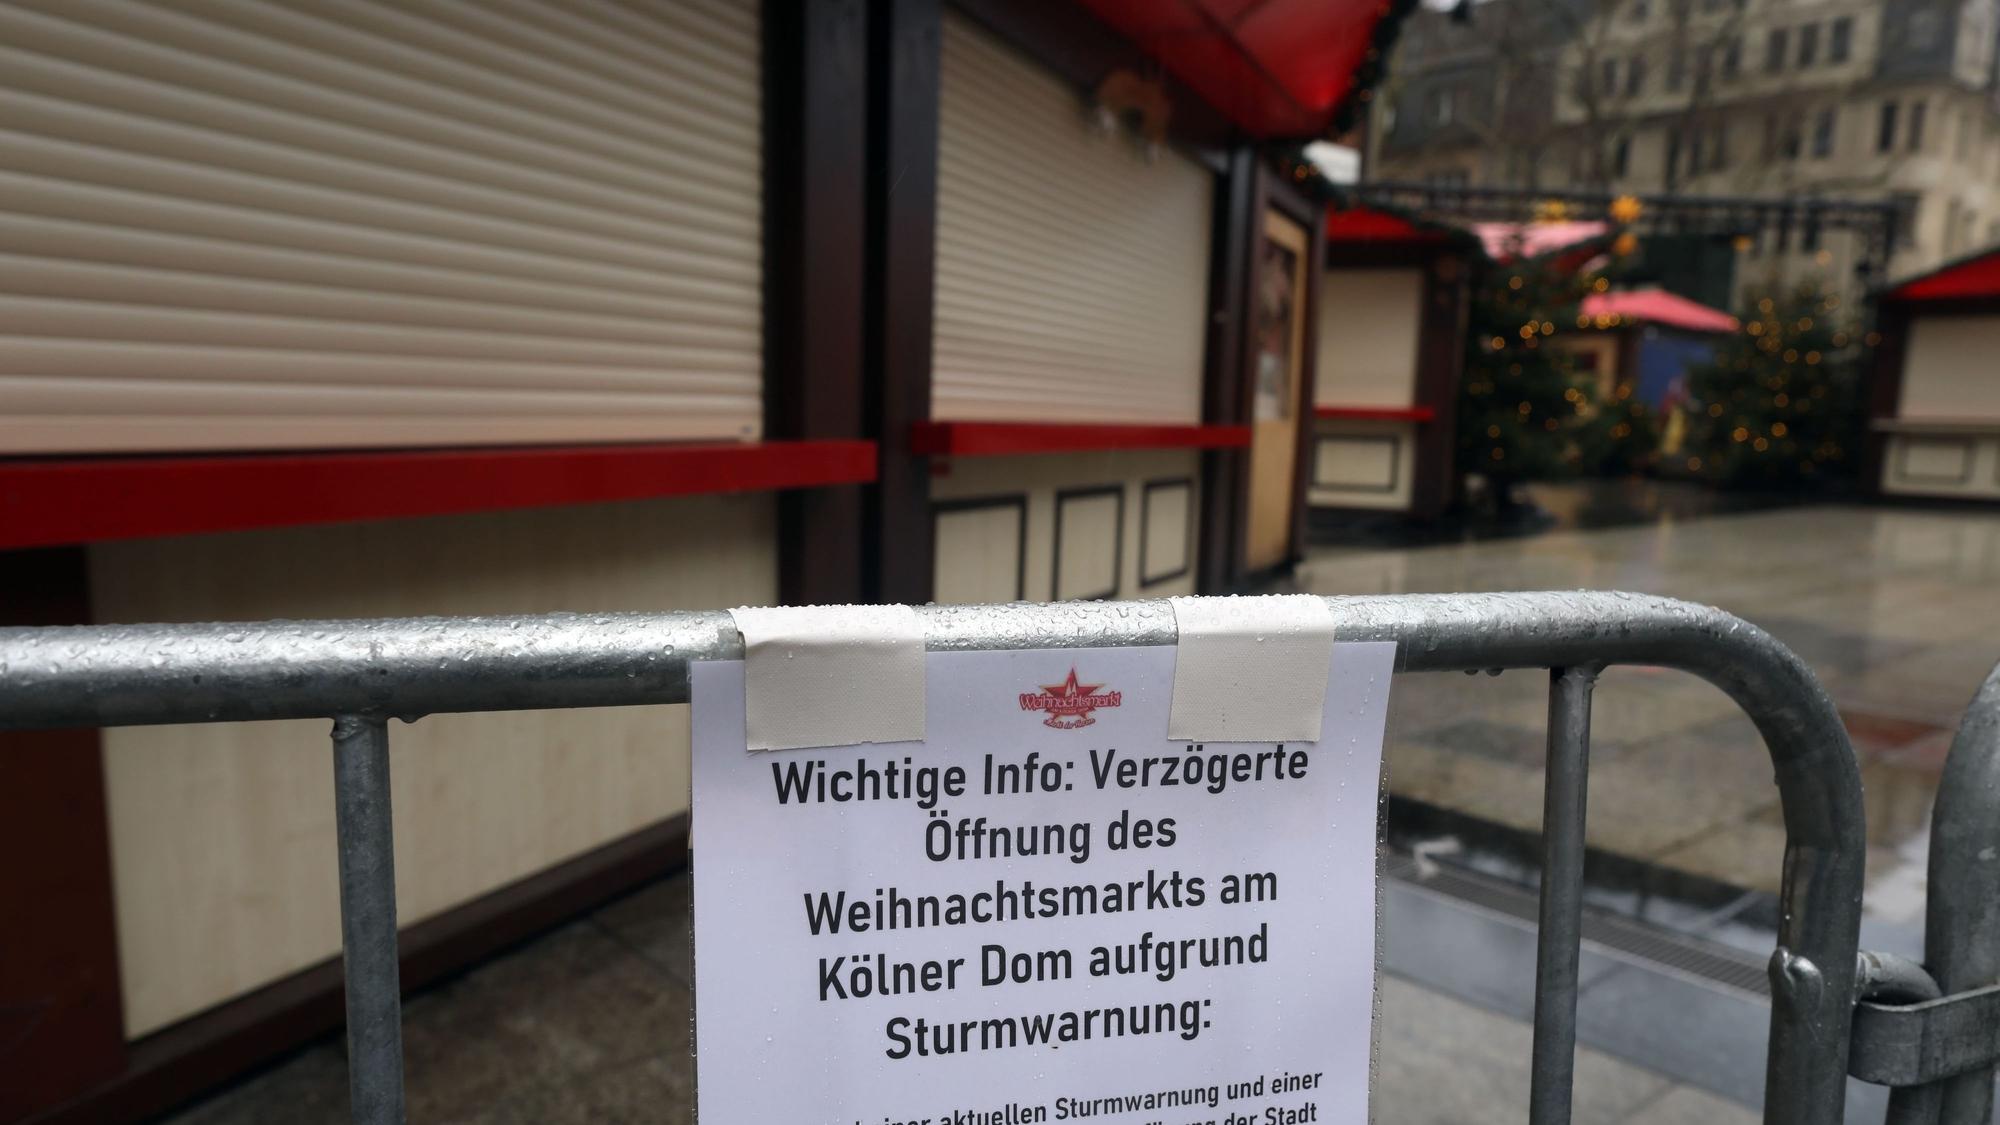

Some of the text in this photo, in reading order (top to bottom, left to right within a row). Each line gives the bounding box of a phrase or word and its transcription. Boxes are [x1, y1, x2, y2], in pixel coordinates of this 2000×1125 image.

[1019, 691, 1121, 711] Weihnachtsmarkt
[771, 744, 1309, 810] Wichtige Info: Verzögerte
[925, 809, 1177, 864] Öffnung des
[803, 869, 1277, 936] Weihnachtsmarkts am
[819, 922, 1268, 1002] Kölner Dom aufgrund
[885, 999, 1211, 1060] Sturmwarnung:
[1055, 1086, 1219, 1120] Sturmwarnung
[1227, 1075, 1264, 1100] und
[1271, 1072, 1323, 1094] einer
[1265, 1102, 1317, 1125] Stadt
